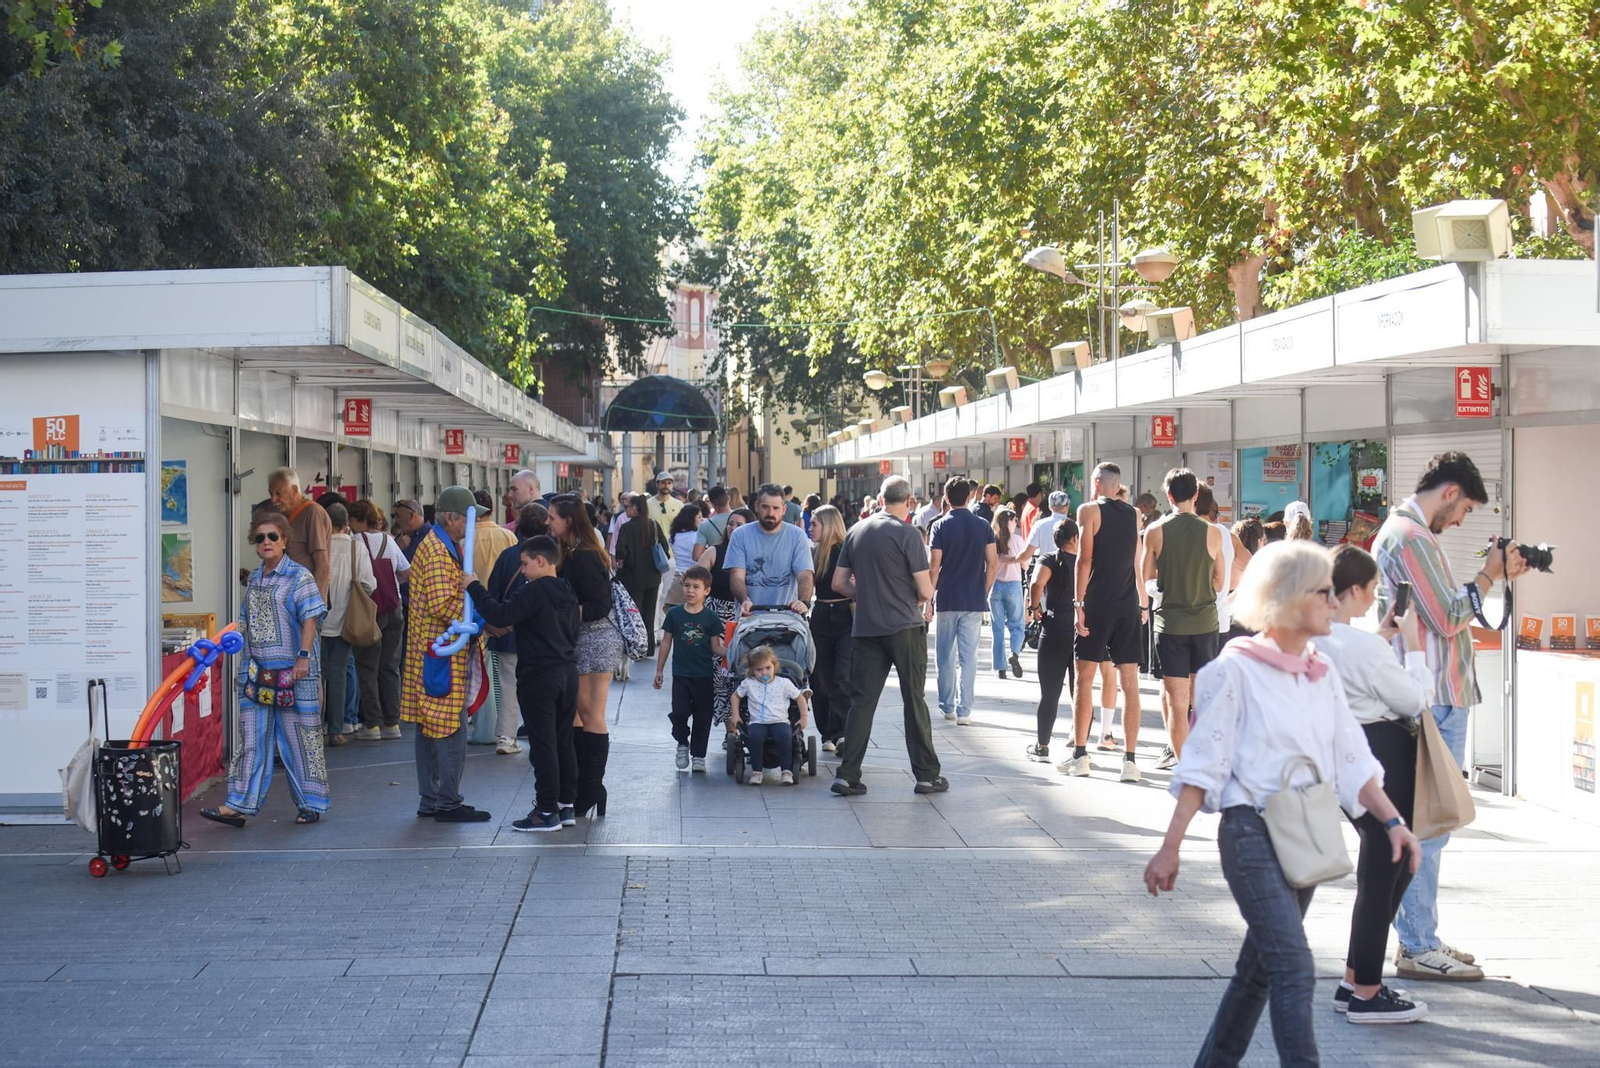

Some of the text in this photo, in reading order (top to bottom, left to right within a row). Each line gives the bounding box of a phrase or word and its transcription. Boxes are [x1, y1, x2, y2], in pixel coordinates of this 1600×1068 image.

[46, 418, 66, 432] 50
[46, 431, 66, 440] FLC
[1271, 460, 1288, 469] 10%
[1470, 592, 1481, 614] SONY
[1527, 619, 1537, 627] 50
[1558, 618, 1568, 626] 50
